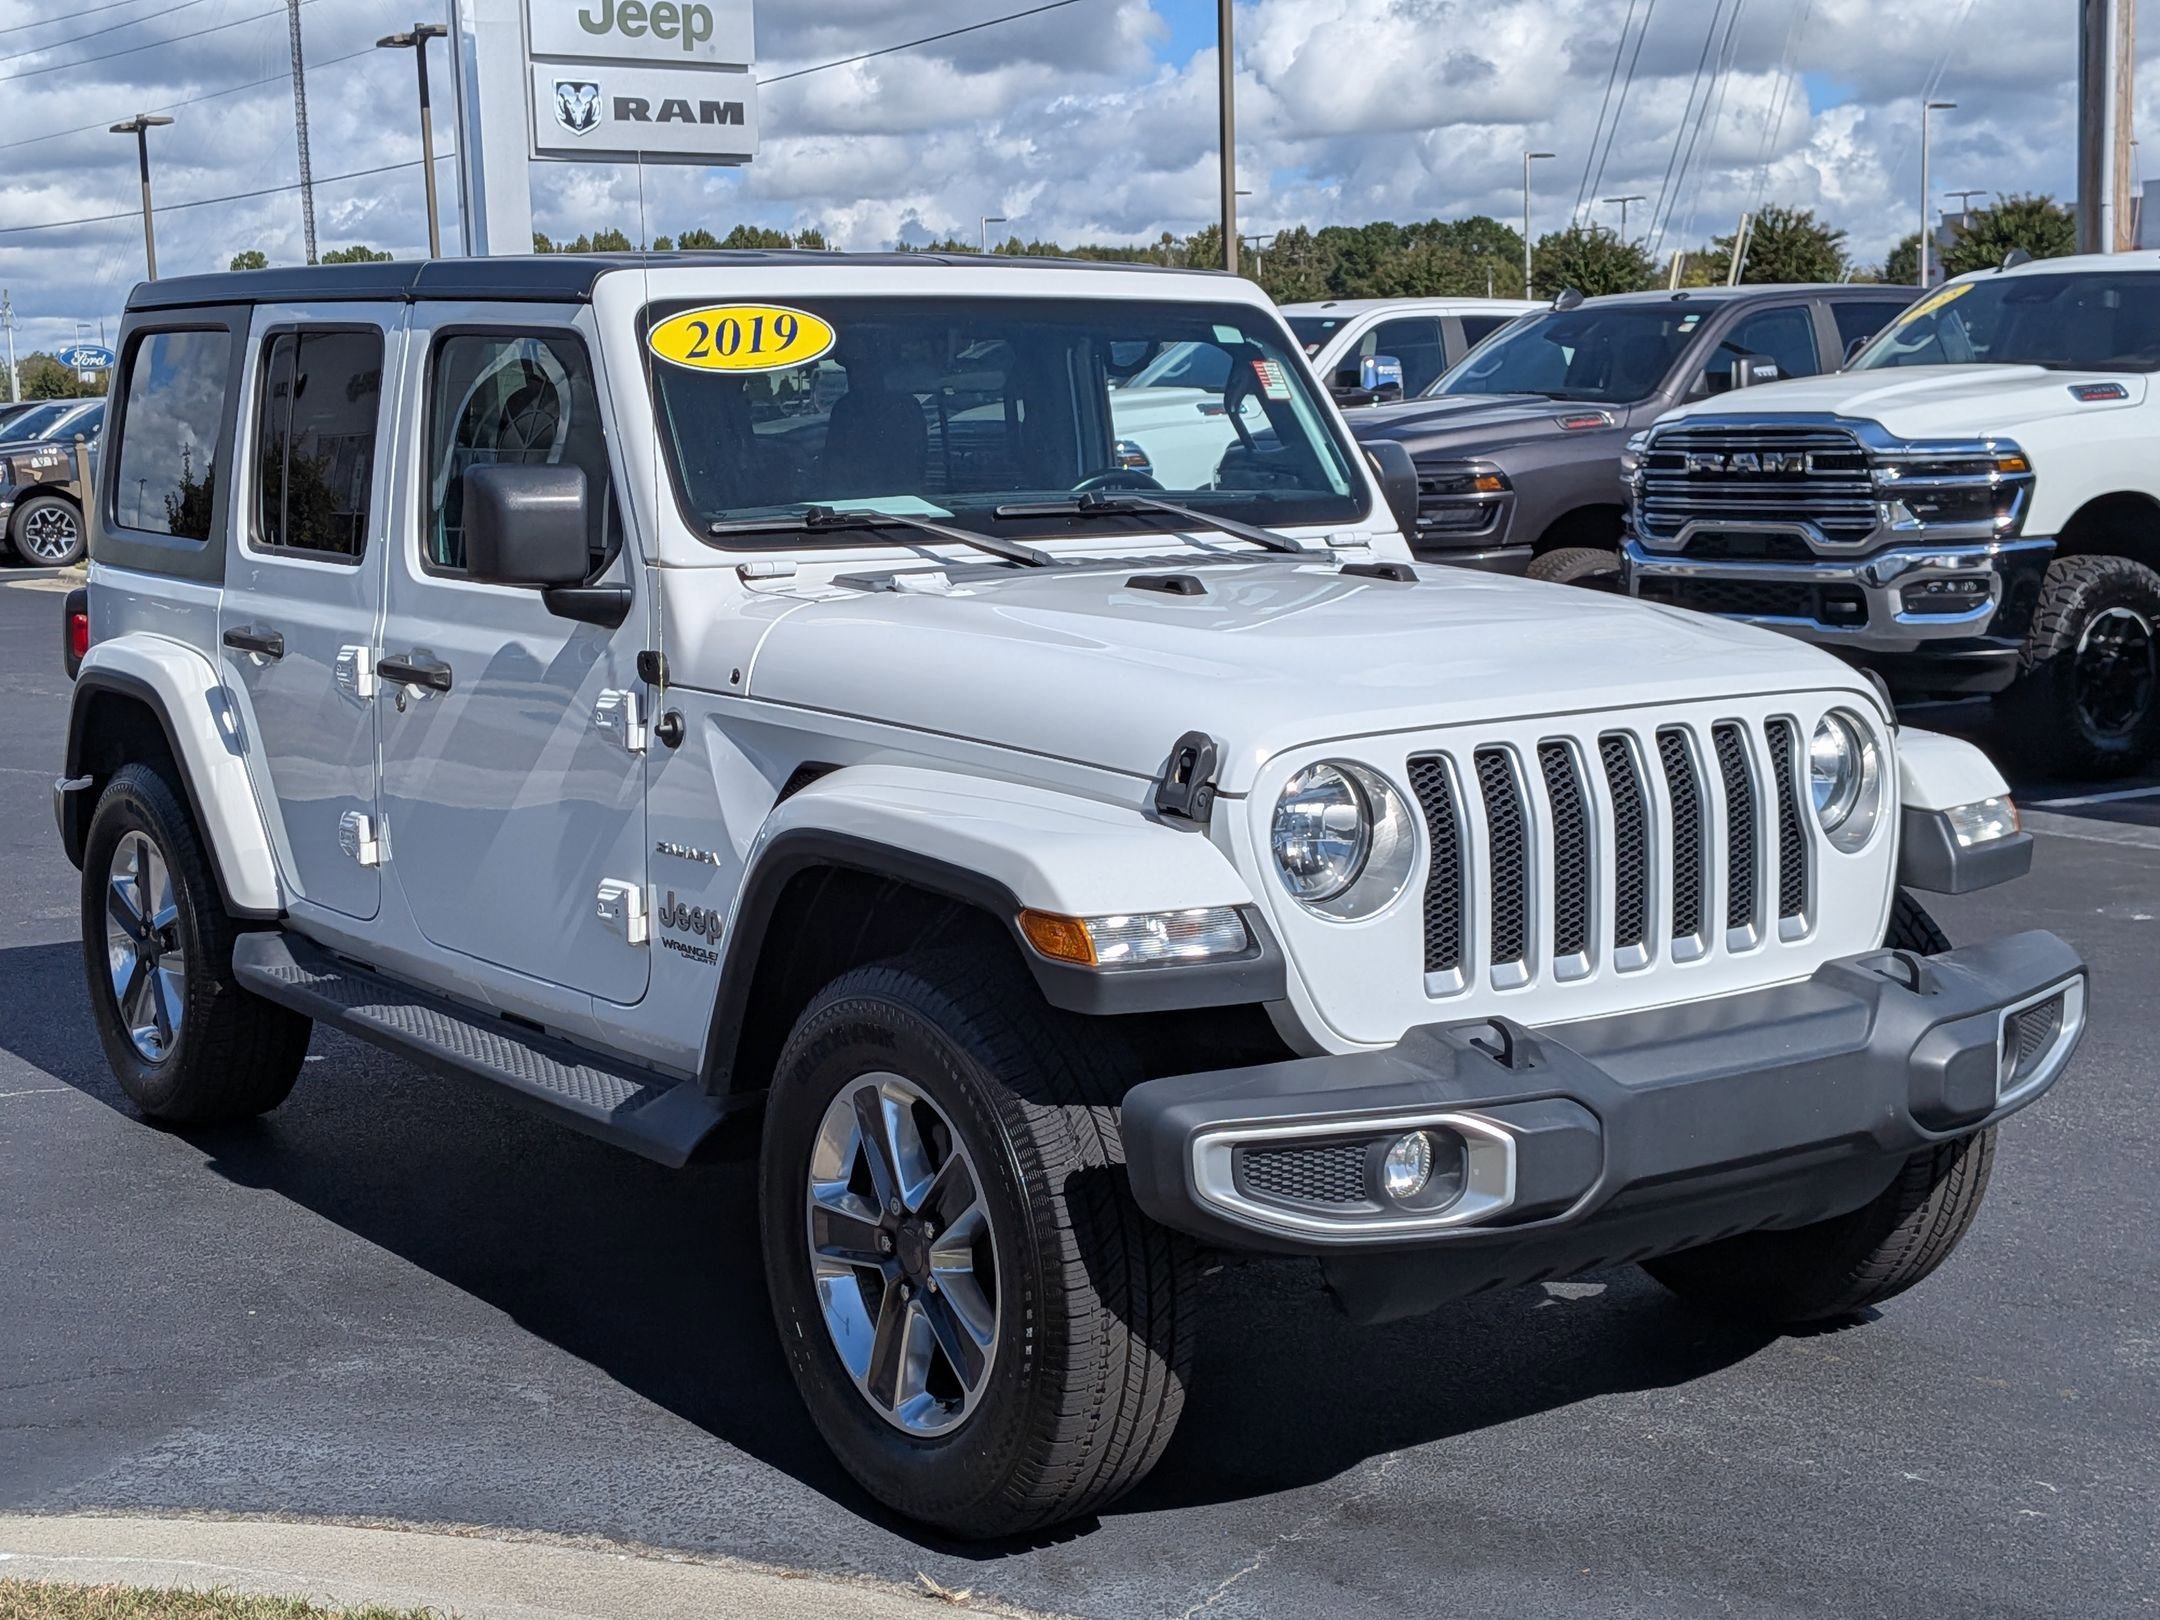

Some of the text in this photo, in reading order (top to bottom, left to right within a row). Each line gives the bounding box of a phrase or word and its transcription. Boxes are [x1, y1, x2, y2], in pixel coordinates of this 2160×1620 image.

[578, 0, 714, 51] Jeep
[613, 97, 745, 125] RAM
[685, 314, 799, 359] 2019
[71, 350, 107, 366] Ford
[1690, 452, 1804, 473] RAM
[659, 890, 722, 946] Jeep
[661, 936, 719, 961] WRANGLE
[681, 952, 717, 967] UNLIMIT
